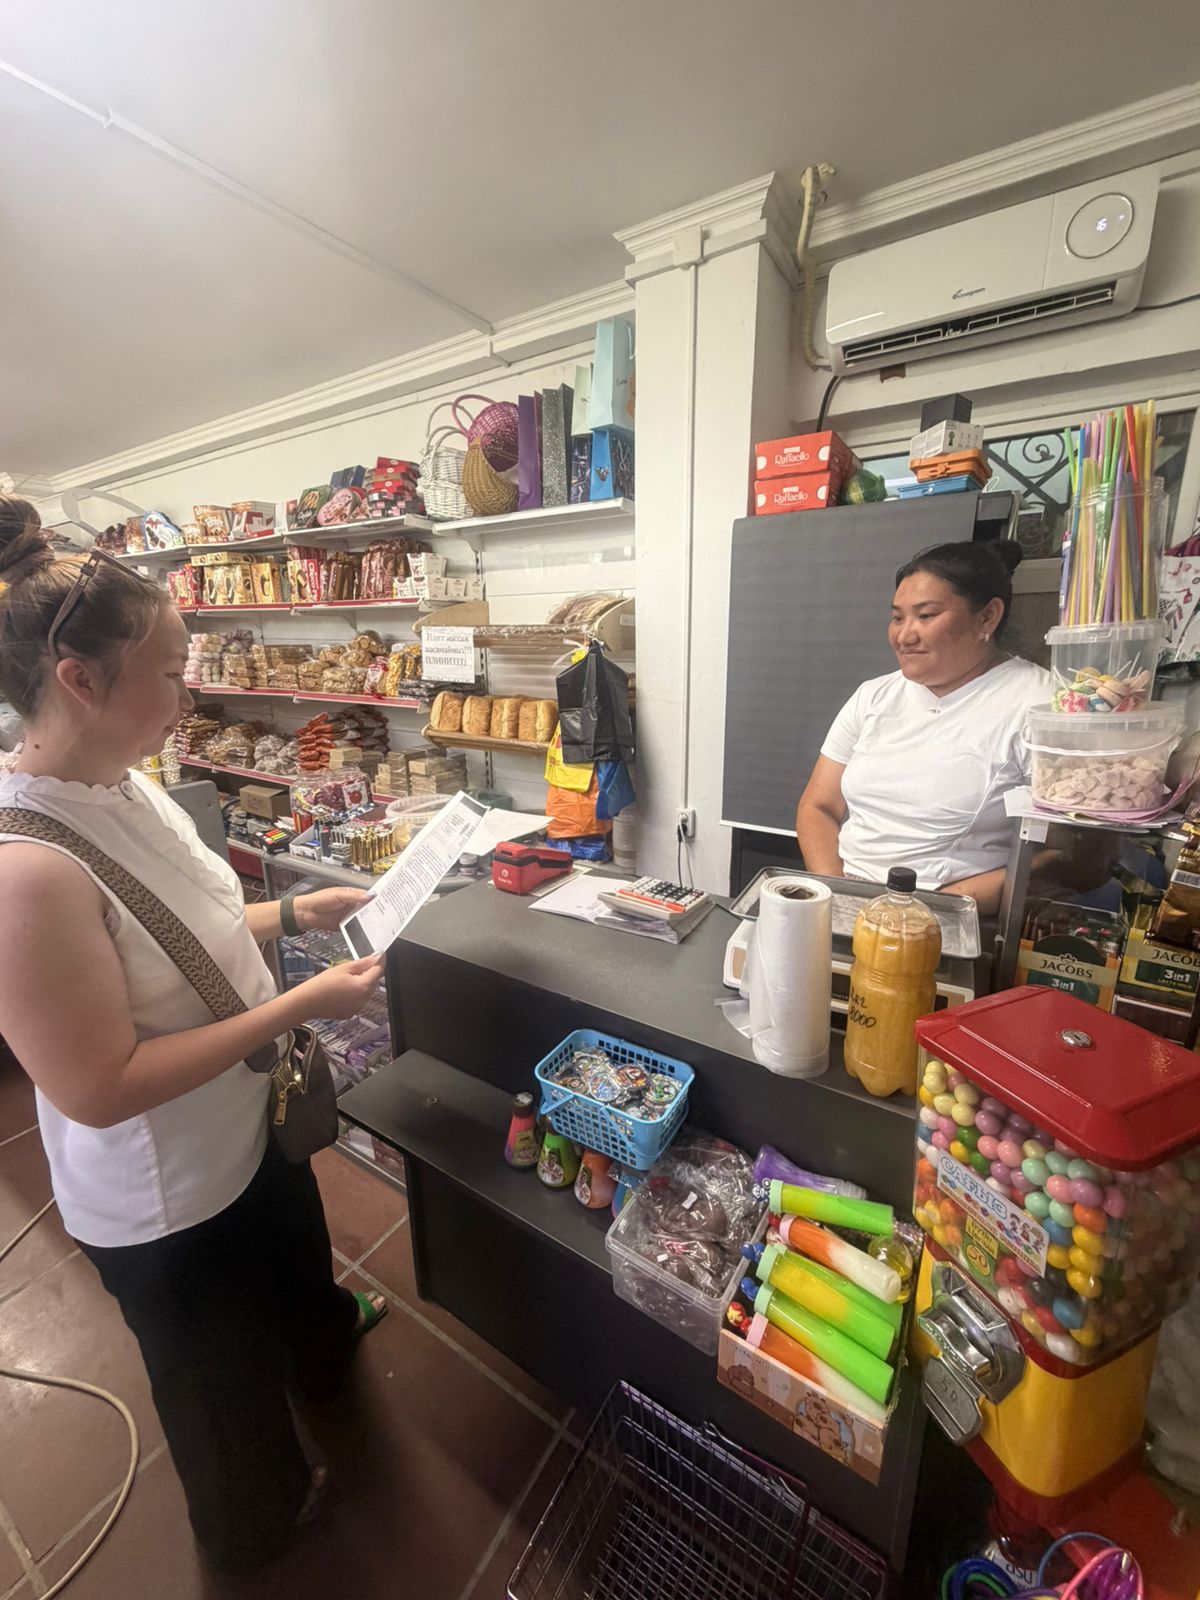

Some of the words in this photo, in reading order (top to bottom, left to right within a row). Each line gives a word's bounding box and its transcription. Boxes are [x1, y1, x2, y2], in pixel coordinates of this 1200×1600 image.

[774, 450, 810, 465] Raffaello
[773, 490, 808, 504] Raffaello
[1151, 948, 1200, 968] JACOB
[1040, 959, 1093, 979] JACOBS
